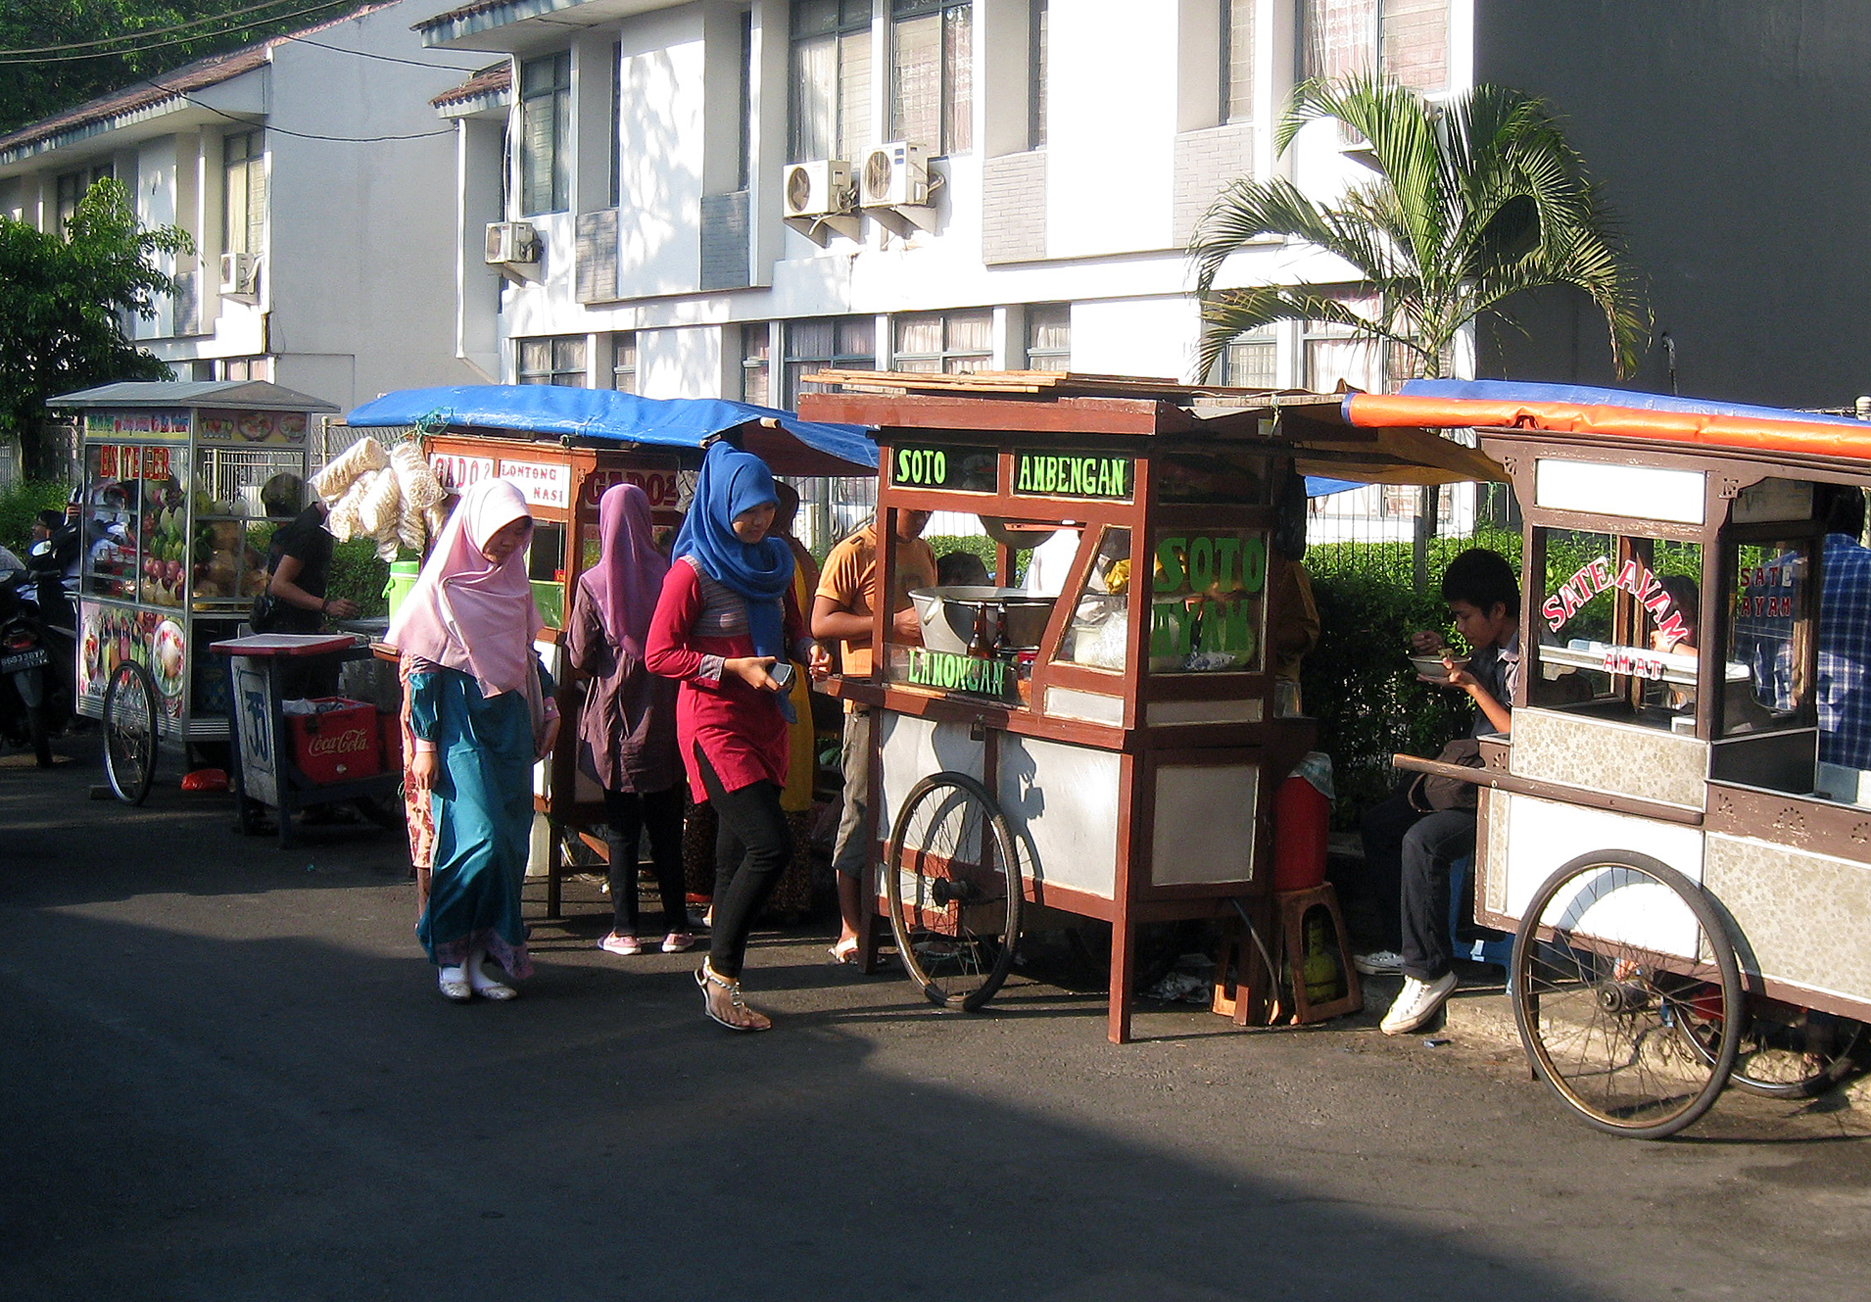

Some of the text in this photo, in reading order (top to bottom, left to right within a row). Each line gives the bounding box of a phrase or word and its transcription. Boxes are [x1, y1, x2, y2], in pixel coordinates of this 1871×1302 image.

[101, 445, 170, 480] ES TELER
[502, 464, 557, 480] LONTONG
[896, 449, 1125, 496] SOTO AMBENGAN
[534, 487, 563, 502] NASI
[1153, 537, 1265, 592] SOTO
[1740, 565, 1793, 587] SATE
[1542, 556, 1689, 650] SATE AYAM
[1740, 596, 1792, 617] AYAM
[1150, 600, 1249, 657] AYAM
[908, 650, 1006, 696] LAMONGAN
[308, 728, 368, 757] Coca-Cola
